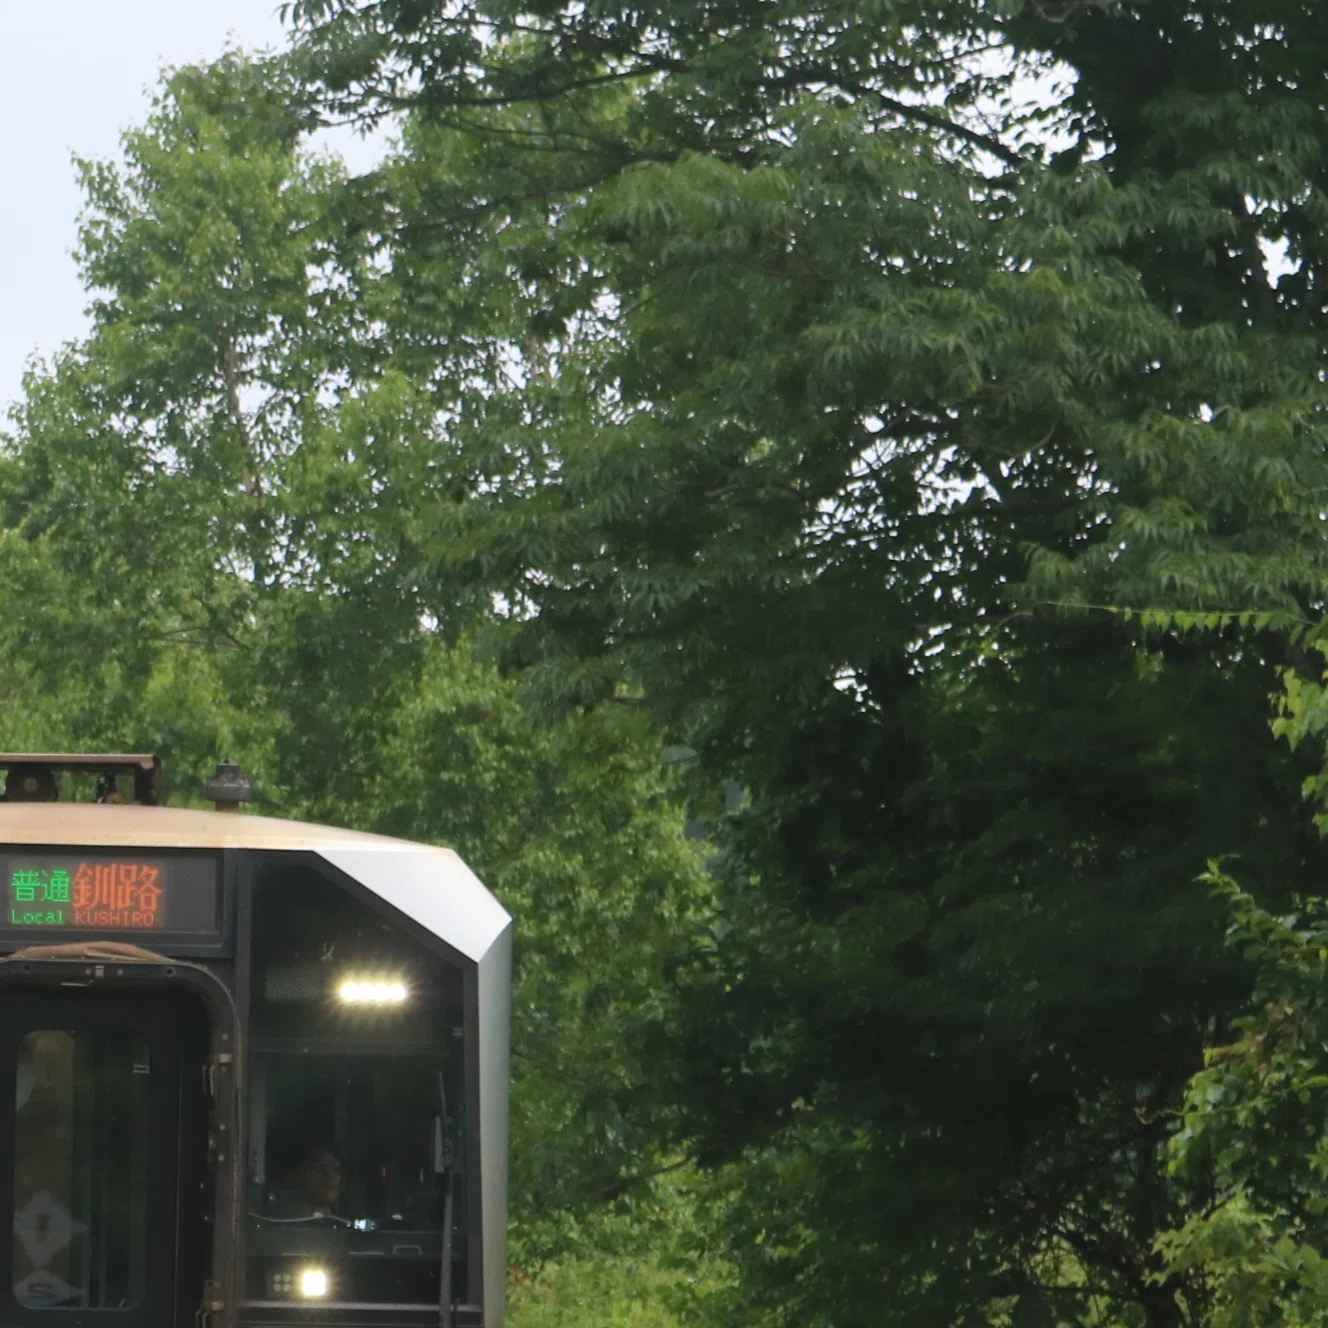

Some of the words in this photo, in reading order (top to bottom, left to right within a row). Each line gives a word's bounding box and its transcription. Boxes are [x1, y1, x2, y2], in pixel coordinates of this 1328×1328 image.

[11, 868, 70, 903] 普通
[71, 862, 162, 912] 釧路
[11, 908, 65, 925] Local
[75, 910, 155, 927] KUSHIRO
